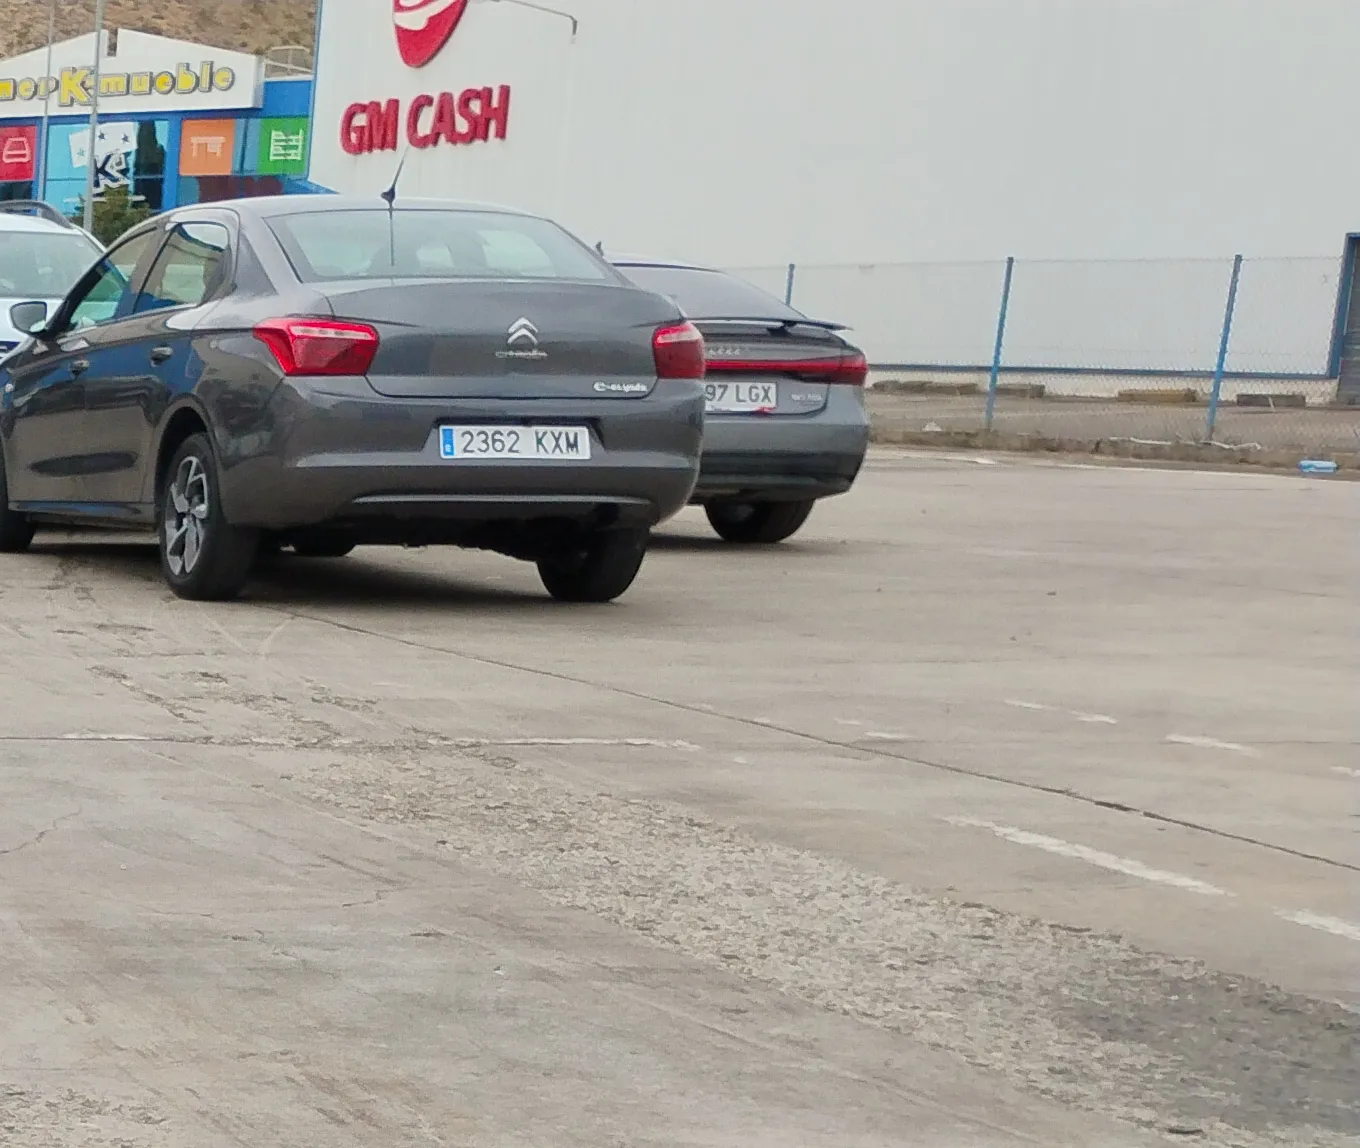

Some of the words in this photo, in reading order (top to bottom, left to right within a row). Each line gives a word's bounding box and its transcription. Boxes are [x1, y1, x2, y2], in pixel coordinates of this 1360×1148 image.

[340, 98, 399, 155] GM
[406, 84, 511, 148] CASH
[735, 384, 772, 403] LGX
[461, 430, 521, 454] 2362
[535, 430, 580, 455] KXM
